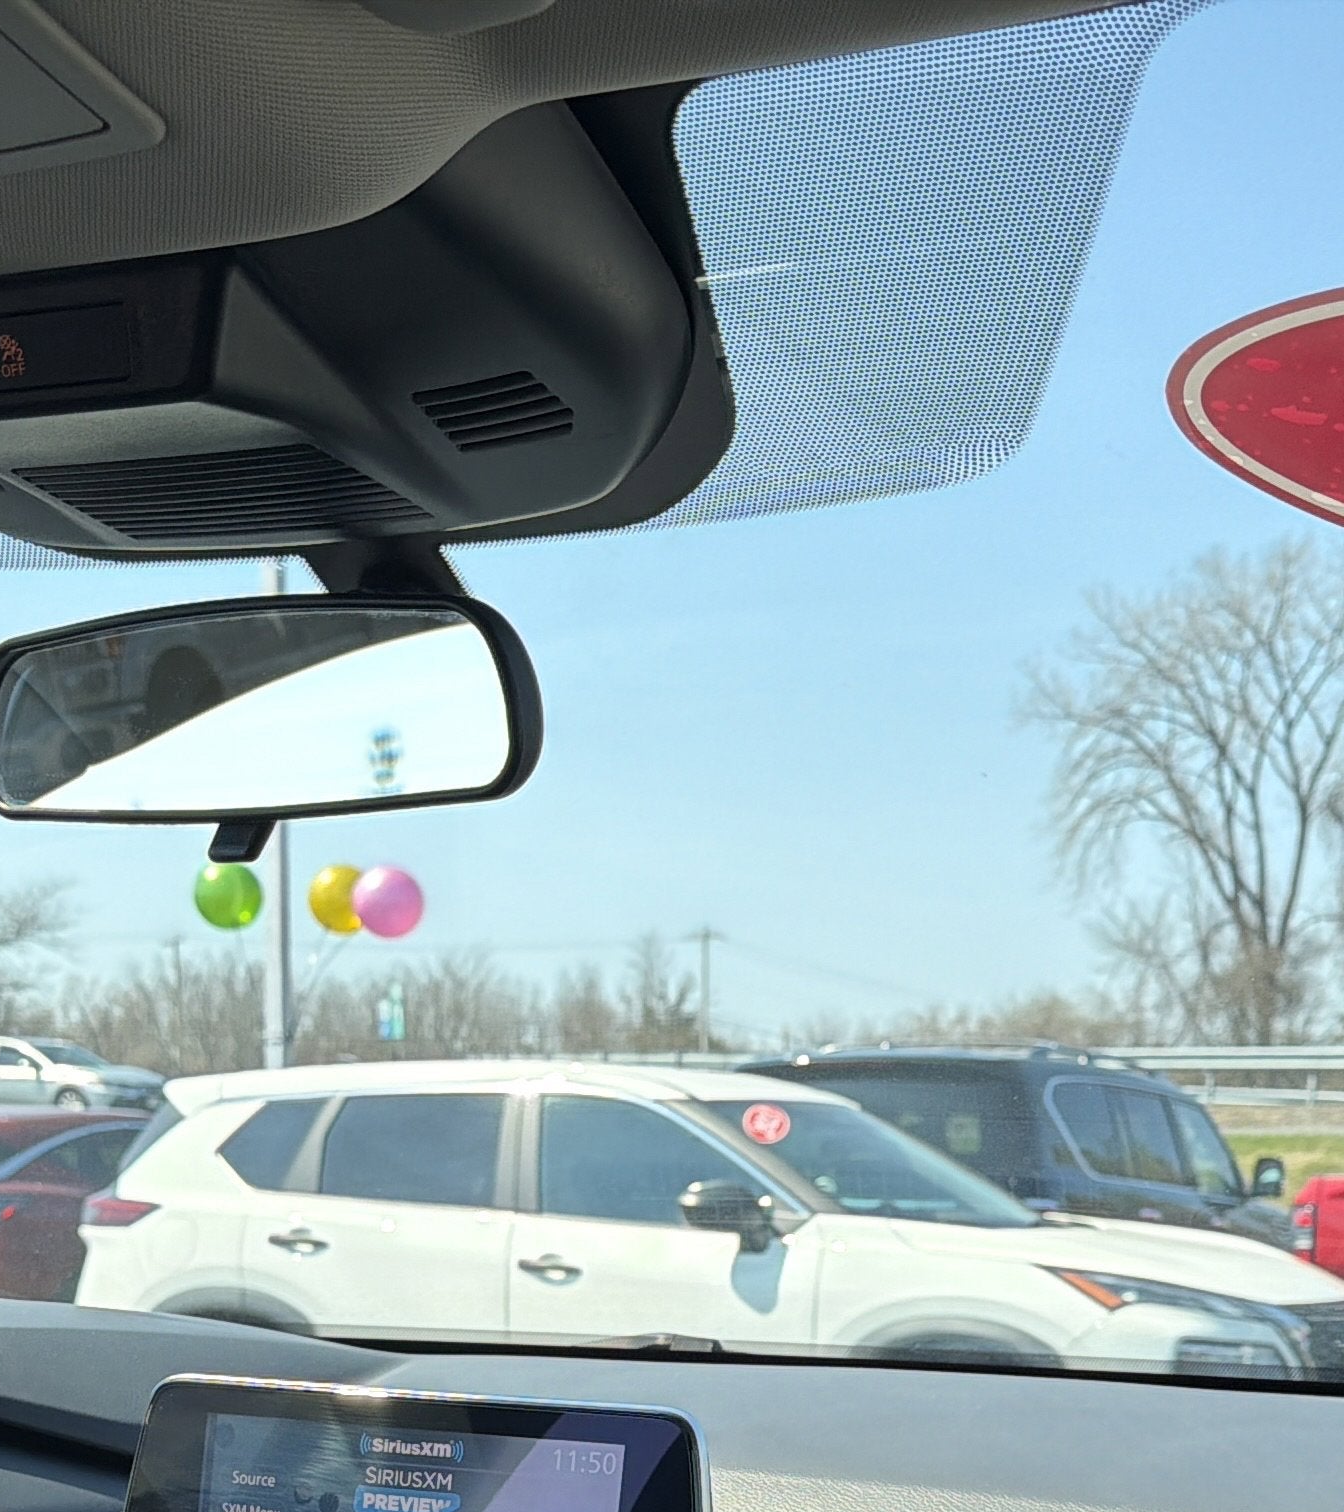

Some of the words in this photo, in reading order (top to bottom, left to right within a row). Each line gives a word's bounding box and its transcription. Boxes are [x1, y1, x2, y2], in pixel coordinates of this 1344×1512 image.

[1, 362, 26, 378] OFF
[553, 1449, 617, 1475] 11:50
[232, 1470, 276, 1488] Source
